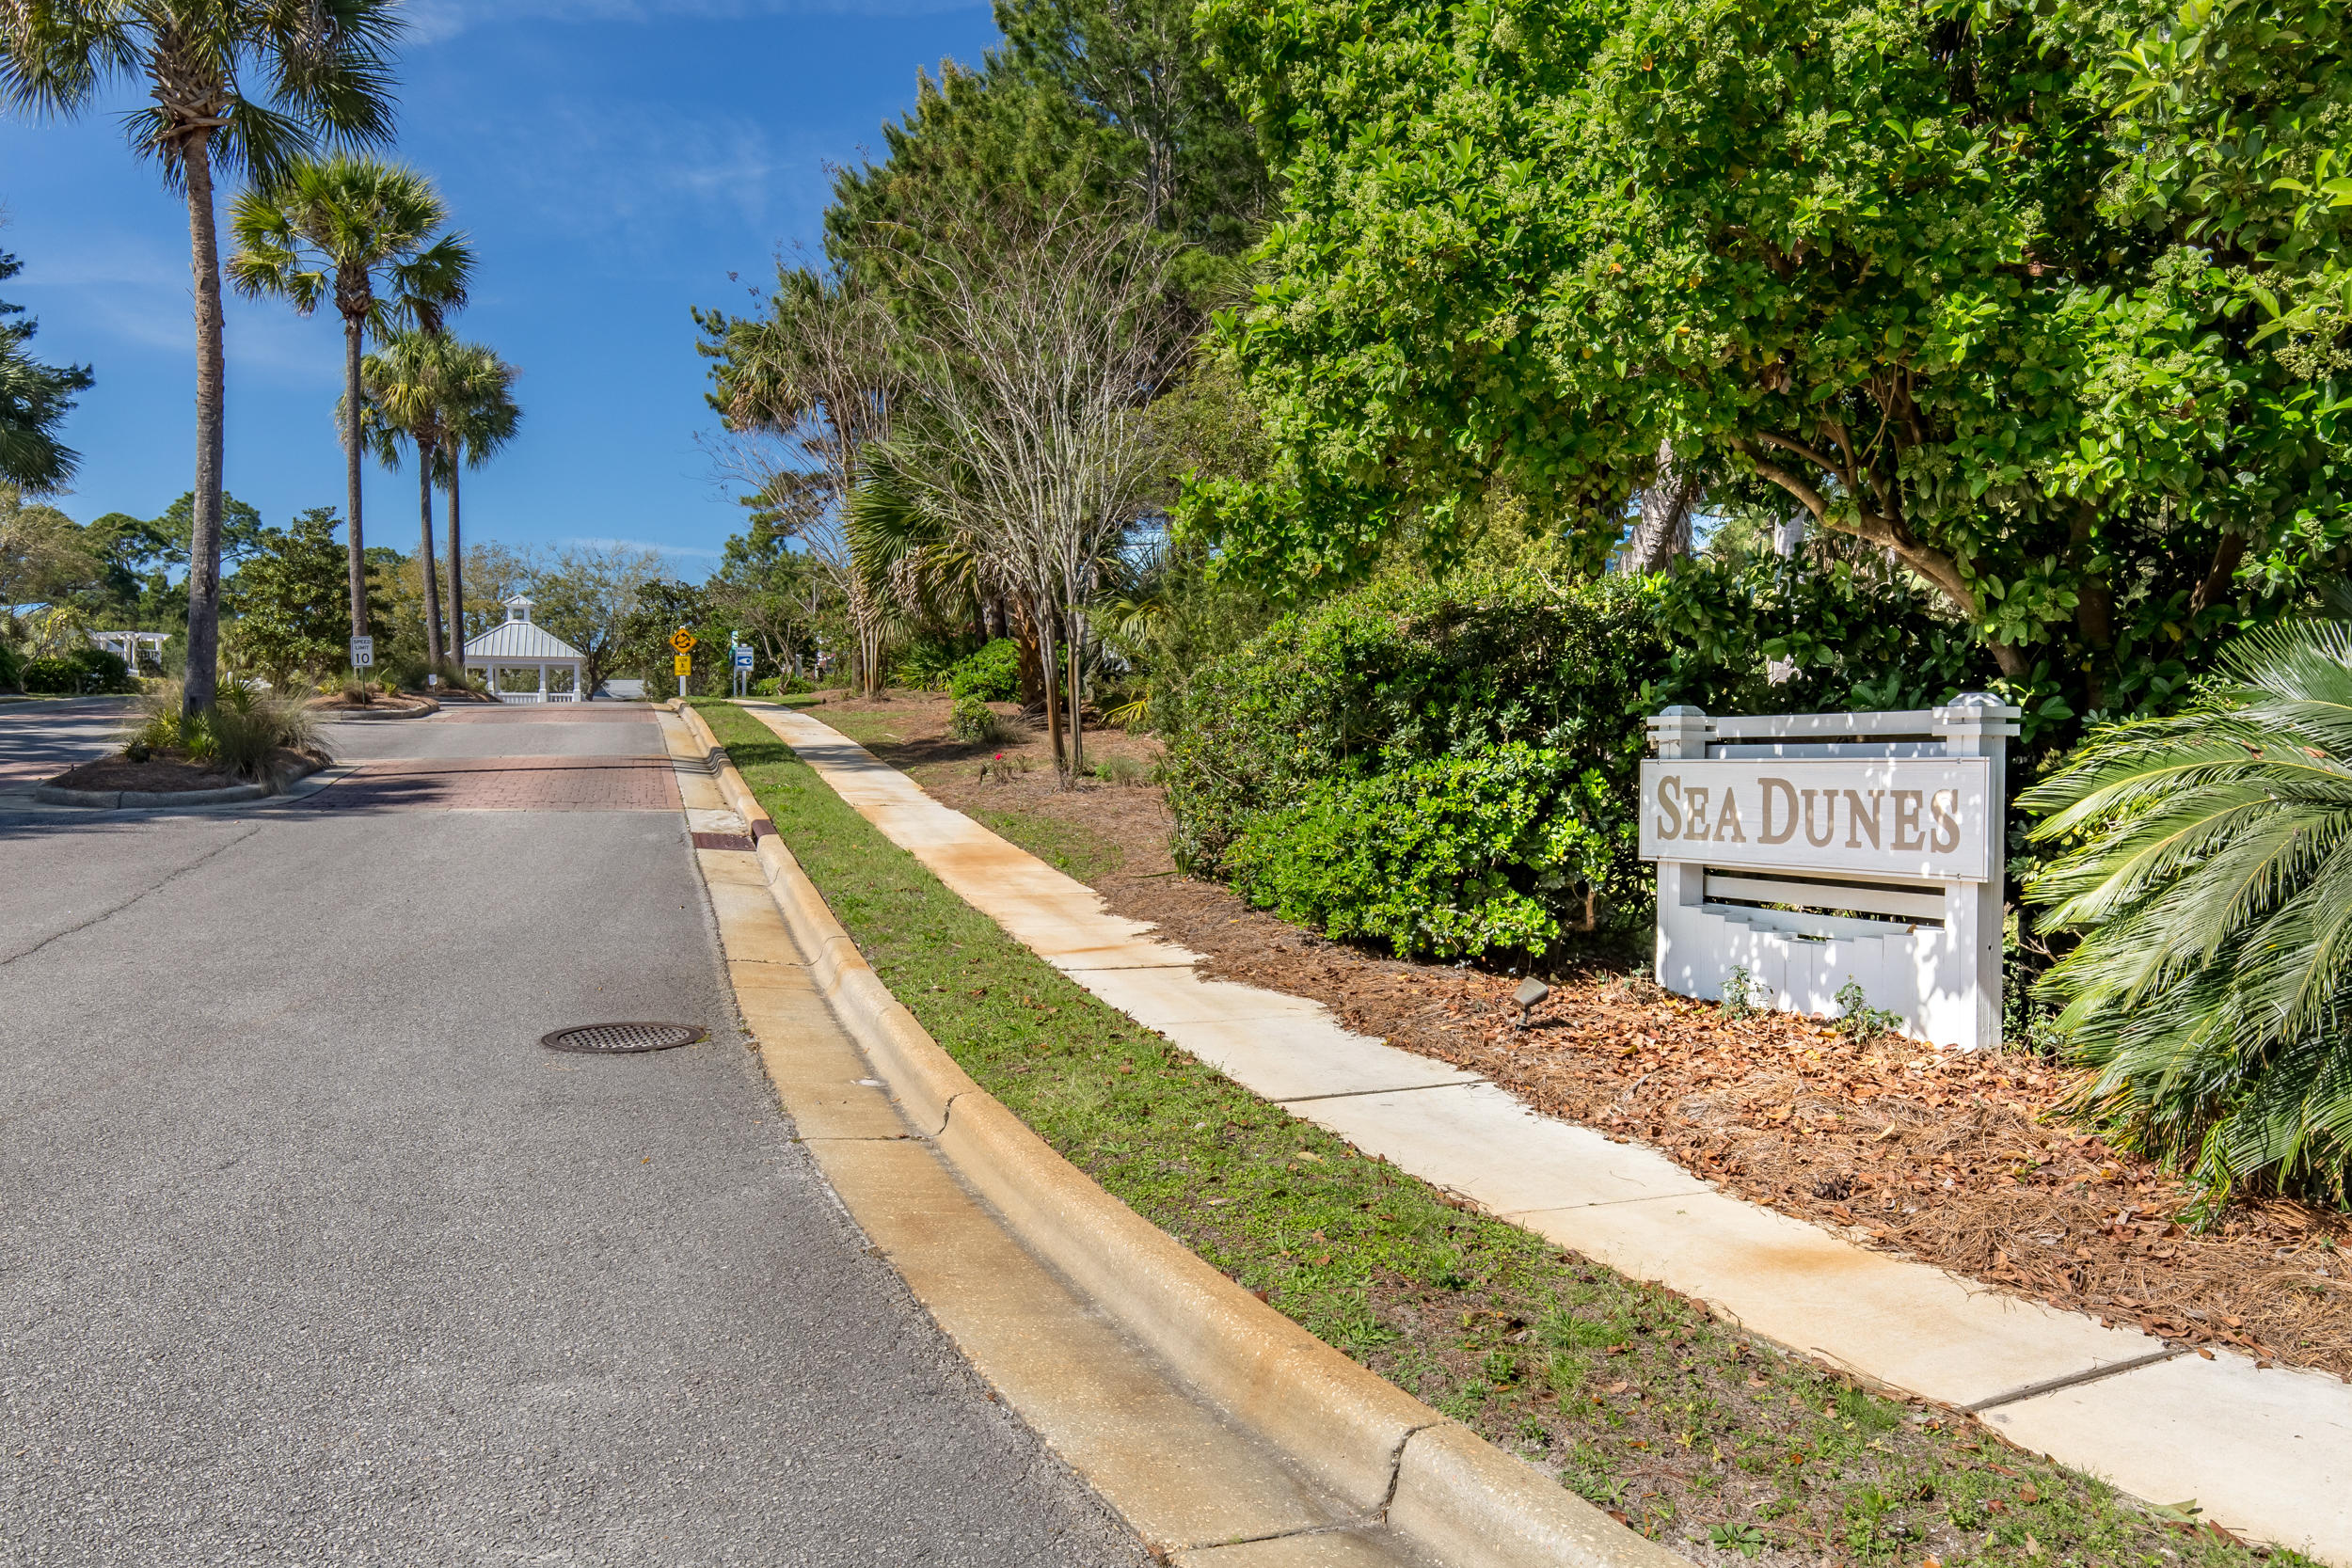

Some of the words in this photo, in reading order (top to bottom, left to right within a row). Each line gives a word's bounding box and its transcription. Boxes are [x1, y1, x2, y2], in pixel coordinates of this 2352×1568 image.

[356, 653, 370, 664] 10
[1657, 776, 1747, 843] SEA
[1756, 778, 1961, 854] DUNES
